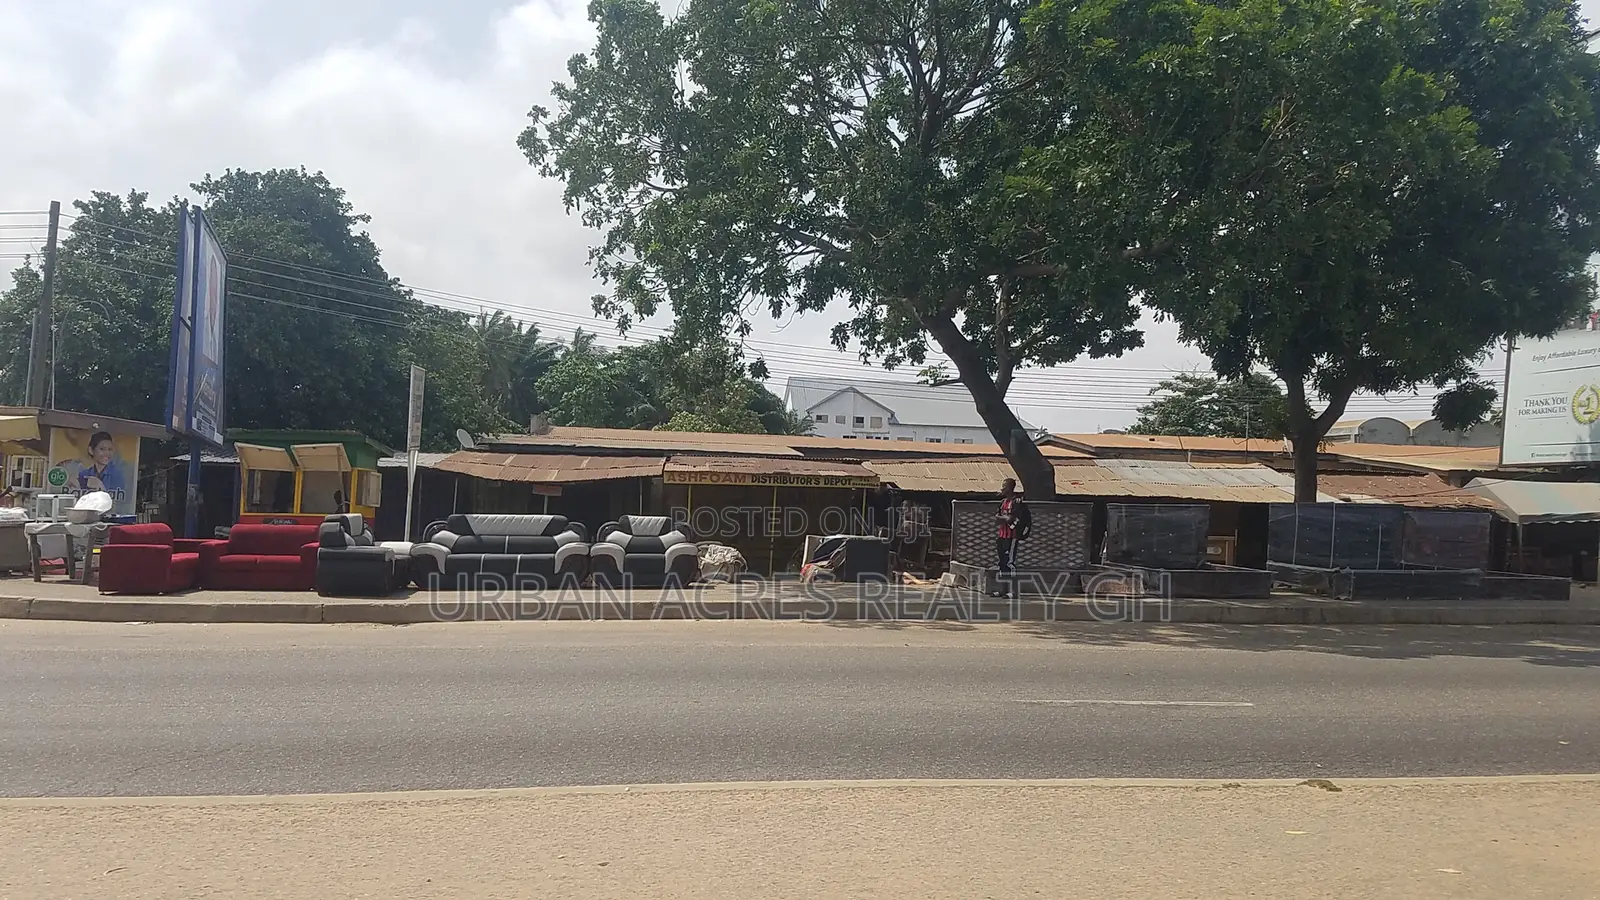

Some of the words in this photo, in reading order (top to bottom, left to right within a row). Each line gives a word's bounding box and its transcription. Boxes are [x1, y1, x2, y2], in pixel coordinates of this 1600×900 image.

[1547, 349, 1576, 359] Affordable
[1577, 348, 1597, 356] Luxury
[1524, 399, 1550, 407] THANK
[1551, 396, 1568, 405] YOU
[1518, 408, 1531, 416] FOR
[1532, 407, 1558, 415] MAKING
[51, 471, 65, 481] glo
[667, 473, 746, 483] ASHFOAM
[750, 474, 821, 486] DISTRIBUTOR'S
